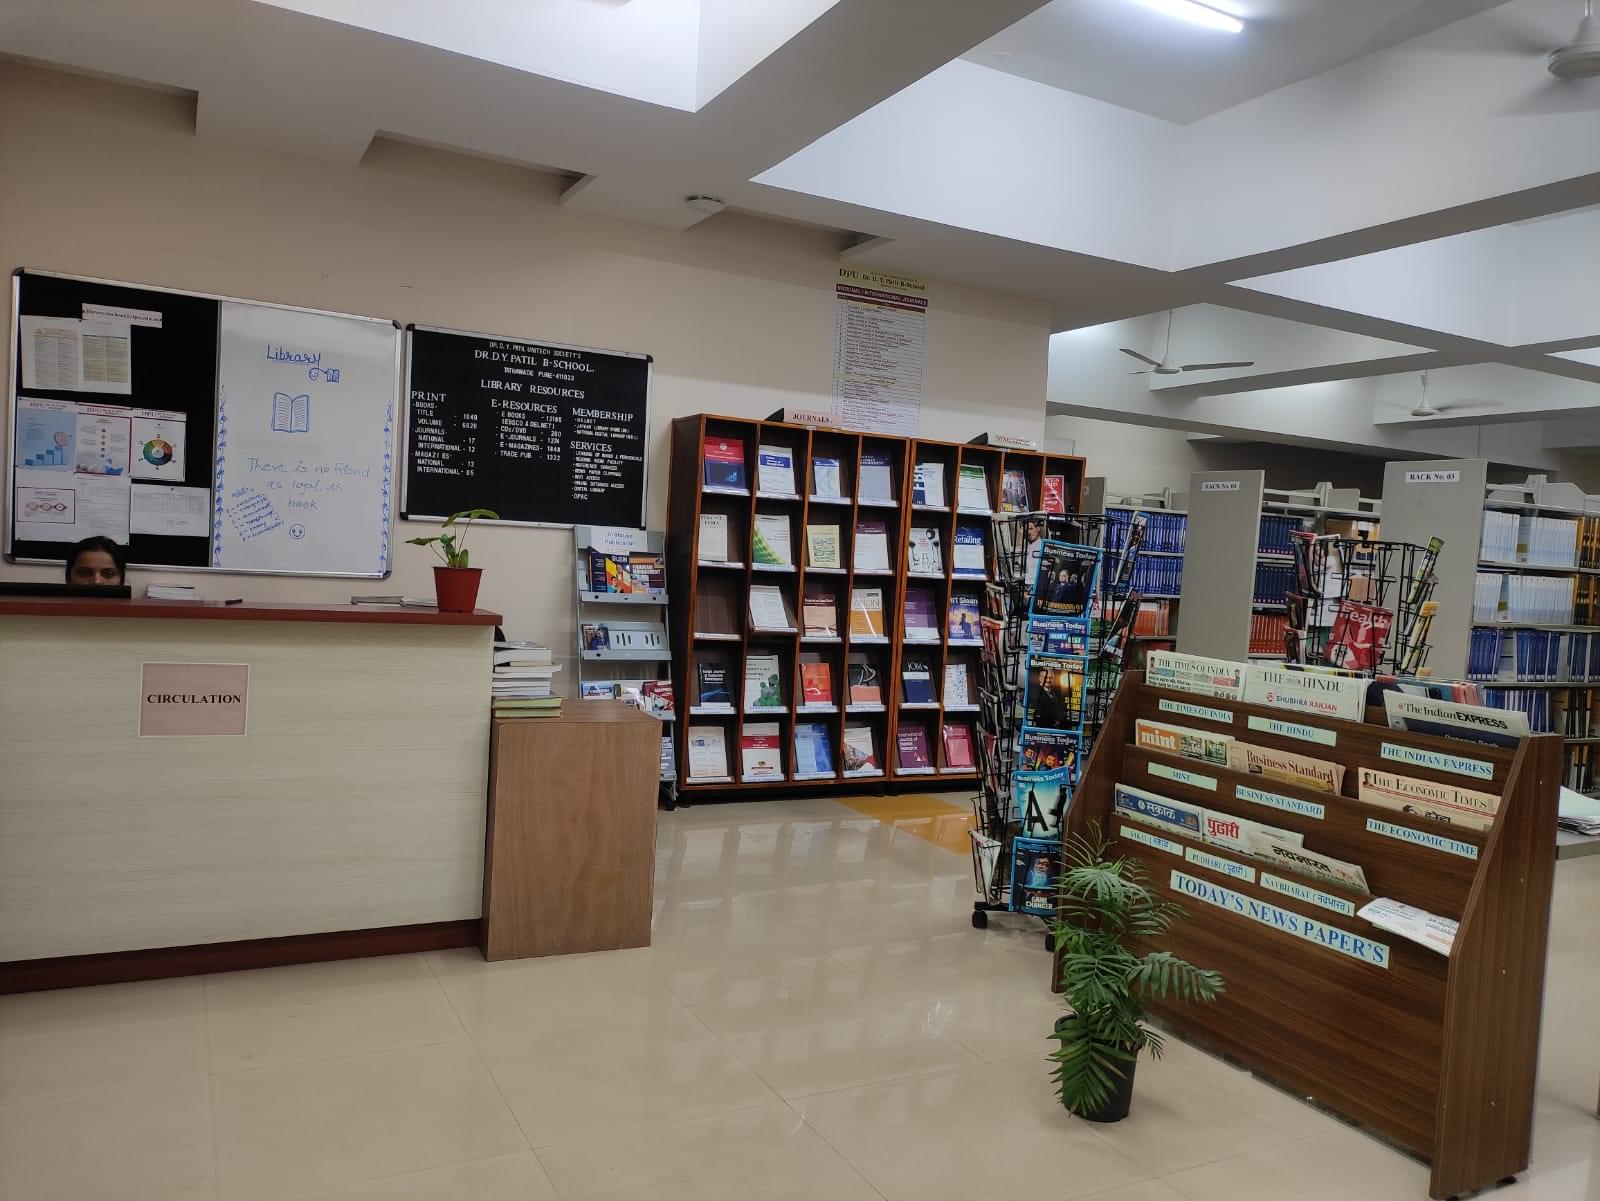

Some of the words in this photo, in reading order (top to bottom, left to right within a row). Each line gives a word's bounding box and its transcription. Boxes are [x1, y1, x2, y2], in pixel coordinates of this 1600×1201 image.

[840, 268, 859, 278] DPU
[266, 344, 320, 366] Library
[511, 354, 537, 365] PATIL
[481, 379, 523, 392] LIBRARY
[530, 385, 585, 399] RESOURCES
[411, 390, 446, 402] PRINT
[491, 399, 558, 414] E-RESOURCES
[572, 408, 633, 422] MEMBERSHIP
[418, 418, 442, 426] VOLUME
[418, 434, 445, 443] NATIONAL
[418, 442, 461, 451] INTERNATIONAL
[570, 441, 612, 453] SERVICES
[500, 450, 518, 458] TRADE
[247, 458, 288, 473] There
[295, 460, 307, 473] is
[314, 464, 330, 474] no
[418, 458, 444, 467] NATIONAL
[1410, 473, 1432, 481] RACK
[266, 481, 282, 489] as
[326, 482, 343, 491] as
[288, 500, 318, 510] book
[1044, 547, 1074, 556] Business
[1075, 552, 1097, 560] Today
[1064, 622, 1085, 630] Today
[1030, 660, 1061, 668] Business
[1063, 662, 1084, 670] Today
[1159, 658, 1171, 668] THE
[1175, 660, 1196, 672] TIMES
[1197, 663, 1205, 673] OF
[1207, 666, 1230, 677] INDIA
[1263, 671, 1285, 684] THE
[1302, 677, 1344, 692] HINDU
[147, 694, 242, 704] CIRCULATION
[1276, 696, 1307, 706] SHUBHRA
[1310, 701, 1337, 711] RANJAN
[1161, 701, 1174, 711] THE
[1175, 703, 1199, 715] TIMES
[1200, 707, 1209, 716] OF
[1210, 709, 1231, 721] INDIA
[1269, 722, 1285, 734] THE
[1287, 725, 1313, 738] HINDU
[1025, 733, 1054, 742] Business
[1057, 735, 1077, 744] Today
[1142, 729, 1177, 750] mint
[1247, 750, 1287, 771] Business
[1288, 760, 1334, 782] Standard
[1382, 746, 1401, 758] THE
[1404, 749, 1440, 766] INDIAN
[1443, 758, 1492, 776] EXPRESS
[1045, 772, 1064, 781] Today
[1172, 772, 1191, 781] MINT
[1373, 773, 1394, 788] THE
[1395, 778, 1449, 800] ECONOMIC
[1451, 789, 1487, 808] TIMES
[1236, 788, 1274, 802] BUSINESS
[1274, 799, 1322, 815] STANDARD
[1368, 821, 1387, 832] THE
[1390, 825, 1446, 848] ECONOMIC
[1448, 841, 1476, 856] TIME
[1192, 853, 1221, 869] PUDHARI
[1265, 878, 1309, 899] NAVBHARAT
[1026, 901, 1053, 910] CHANGER
[1176, 874, 1243, 912] TODAY'S
[1248, 900, 1298, 932] NEWS
[1303, 919, 1384, 963] PAPER'S
